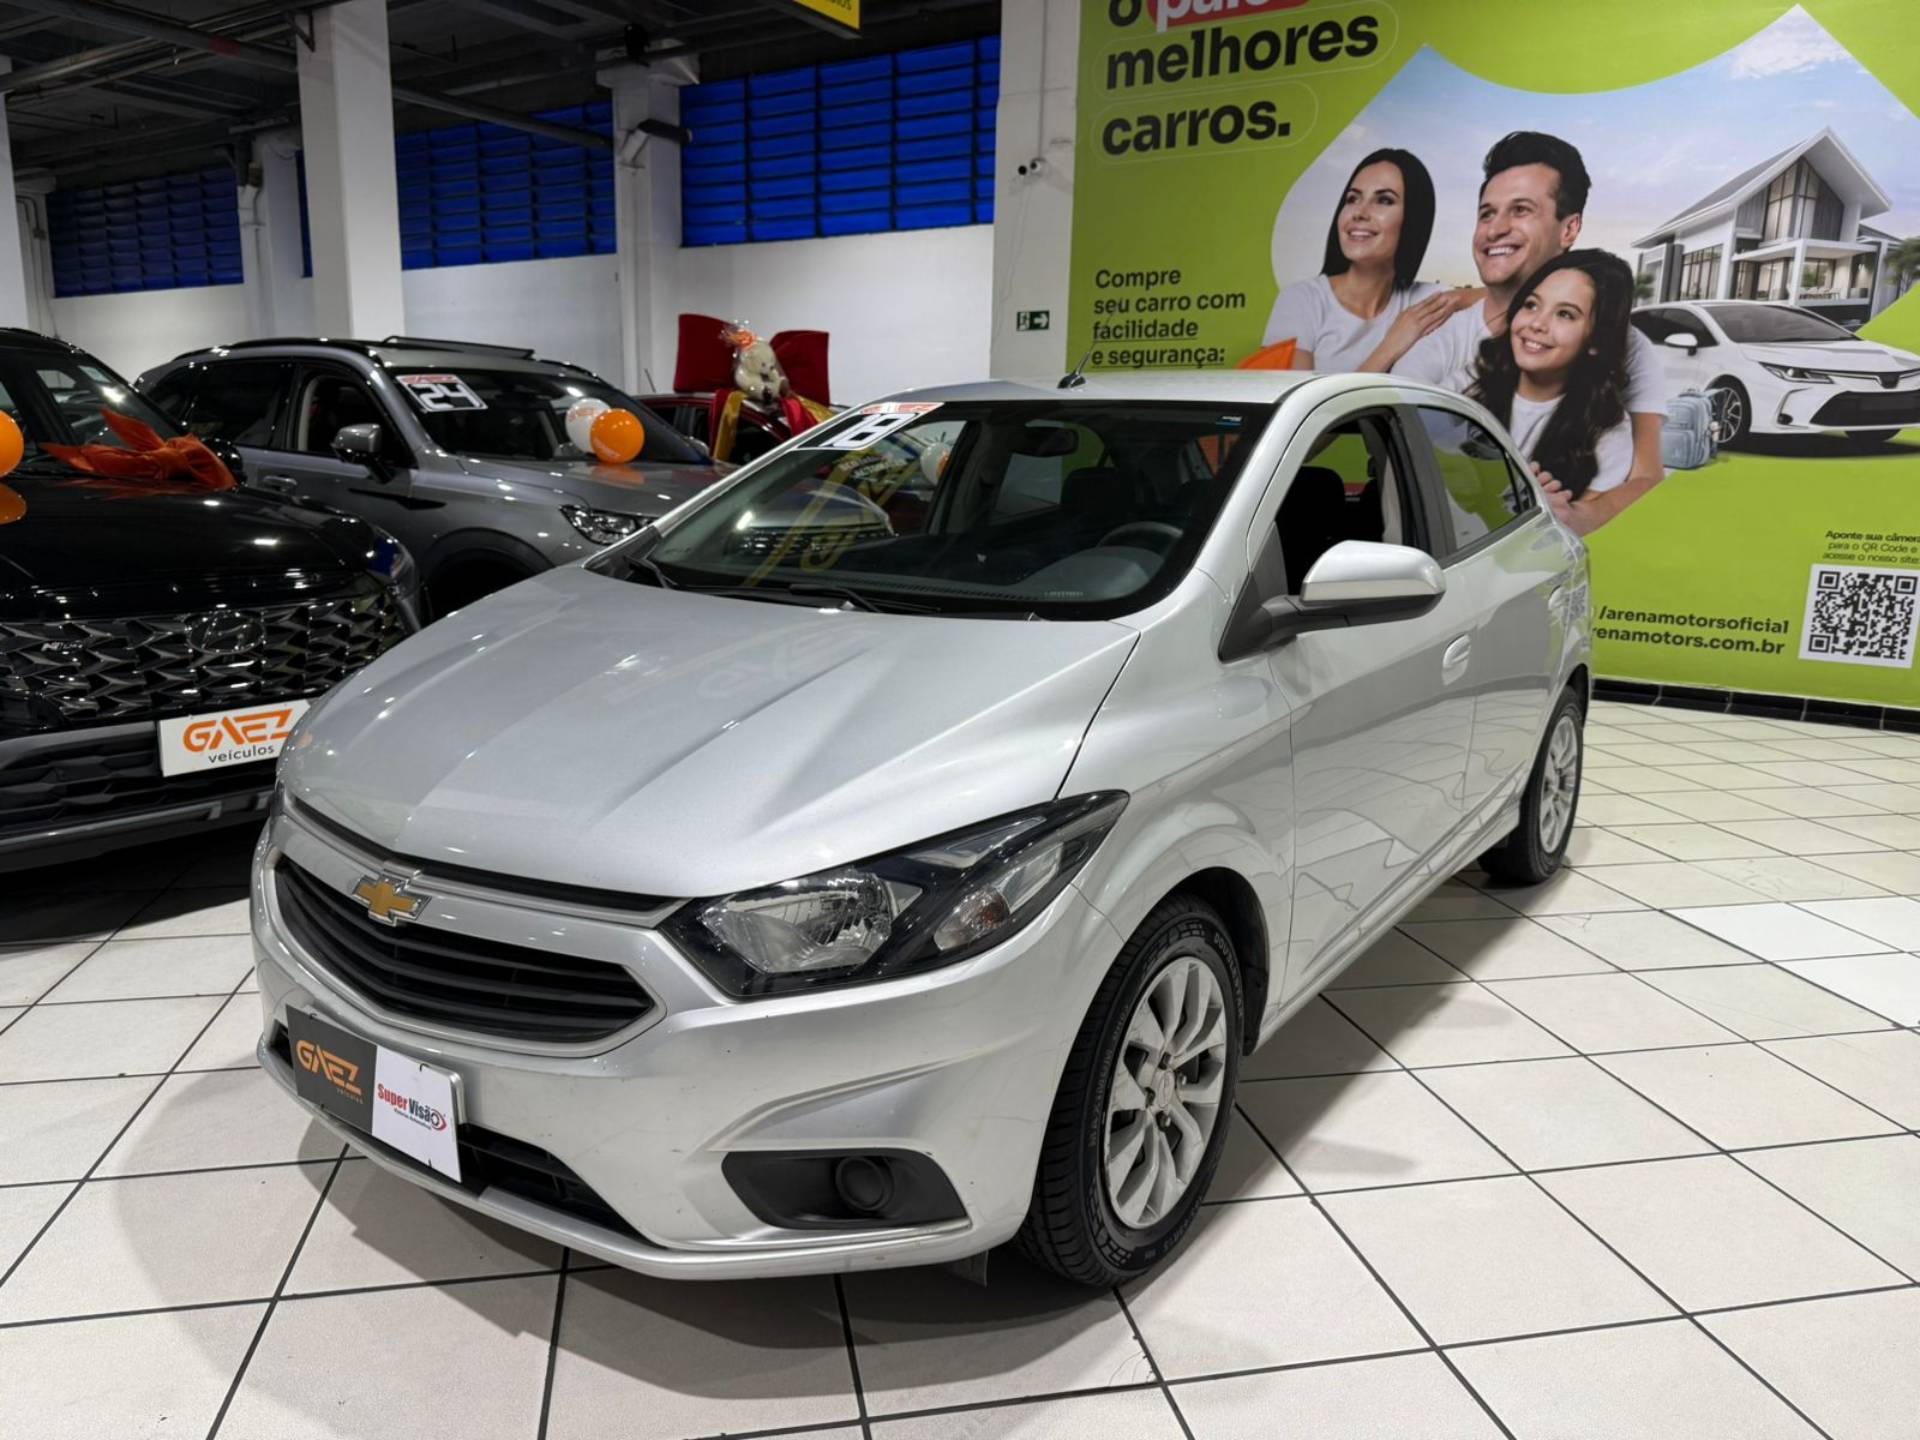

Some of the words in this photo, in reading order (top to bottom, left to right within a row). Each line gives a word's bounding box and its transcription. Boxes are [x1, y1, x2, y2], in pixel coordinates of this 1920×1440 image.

[1106, 15, 1379, 90] melhores
[1102, 101, 1291, 156] carros.
[1095, 269, 1181, 290] Compre
[1094, 298, 1129, 314] seu
[1135, 295, 1191, 312] carro
[1197, 292, 1246, 310] com
[1093, 318, 1199, 340] facilidade
[1092, 350, 1103, 365] e
[1108, 347, 1225, 369] segurança:
[411, 383, 481, 408] 24
[1825, 530, 1863, 541] Aponte
[1823, 553, 1855, 561] acesse
[1867, 555, 1897, 563] nosso
[1828, 542, 1850, 551] para
[1862, 543, 1877, 553] QR
[1881, 543, 1908, 553] Code
[1598, 605, 1789, 634] /arenamotorsoficial
[208, 745, 274, 764] veículos
[377, 1083, 408, 1110] Super
